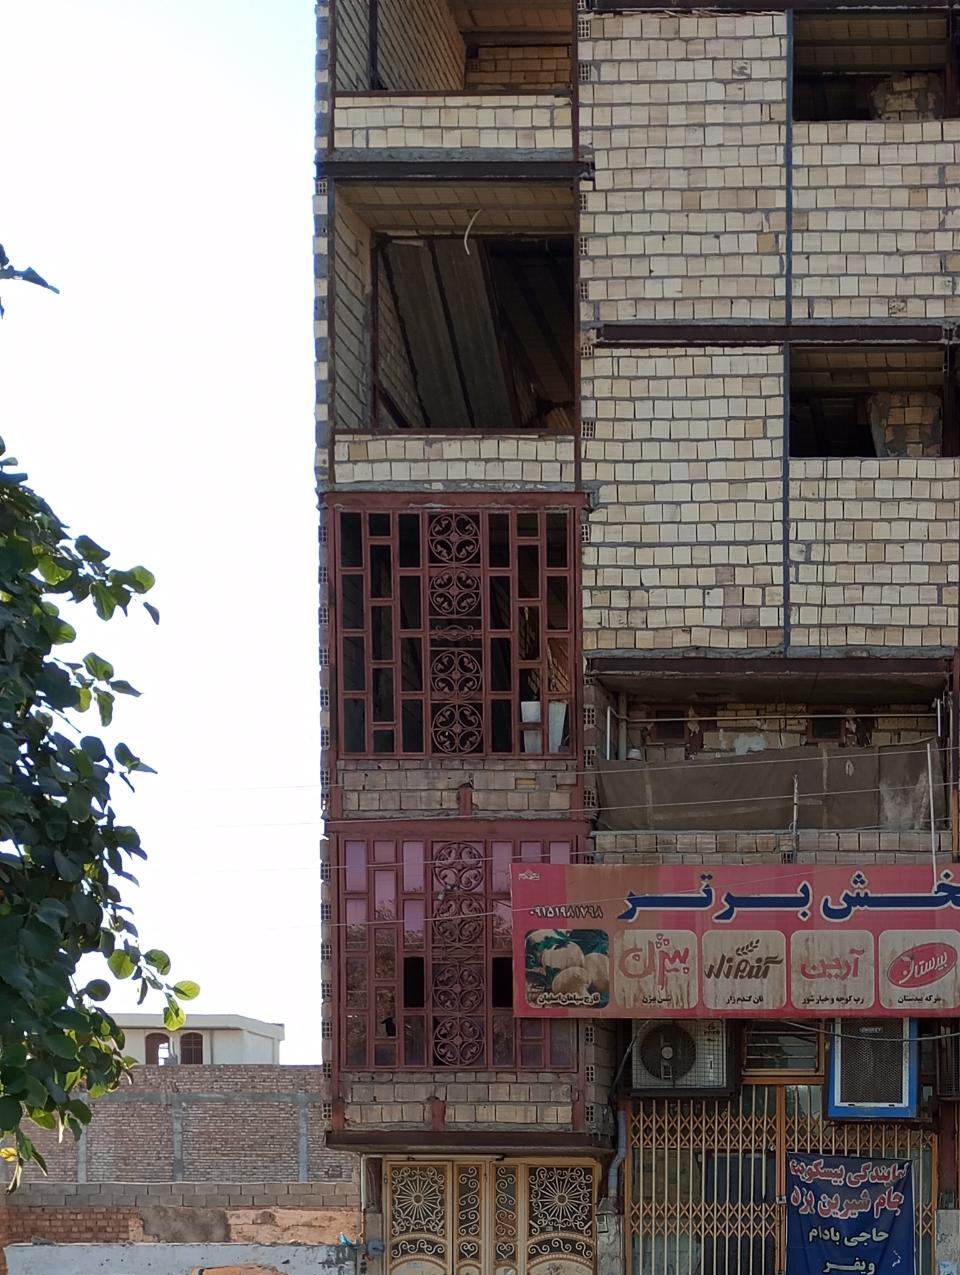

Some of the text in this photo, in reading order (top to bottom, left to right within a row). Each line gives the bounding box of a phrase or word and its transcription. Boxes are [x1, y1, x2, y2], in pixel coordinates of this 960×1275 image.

[617, 871, 814, 922] برتر
[801, 947, 865, 981] آرین
[818, 1188, 872, 1219] شیرین
[809, 1226, 889, 1246] حاجی بادام
[822, 1256, 875, 1275] ویفر
